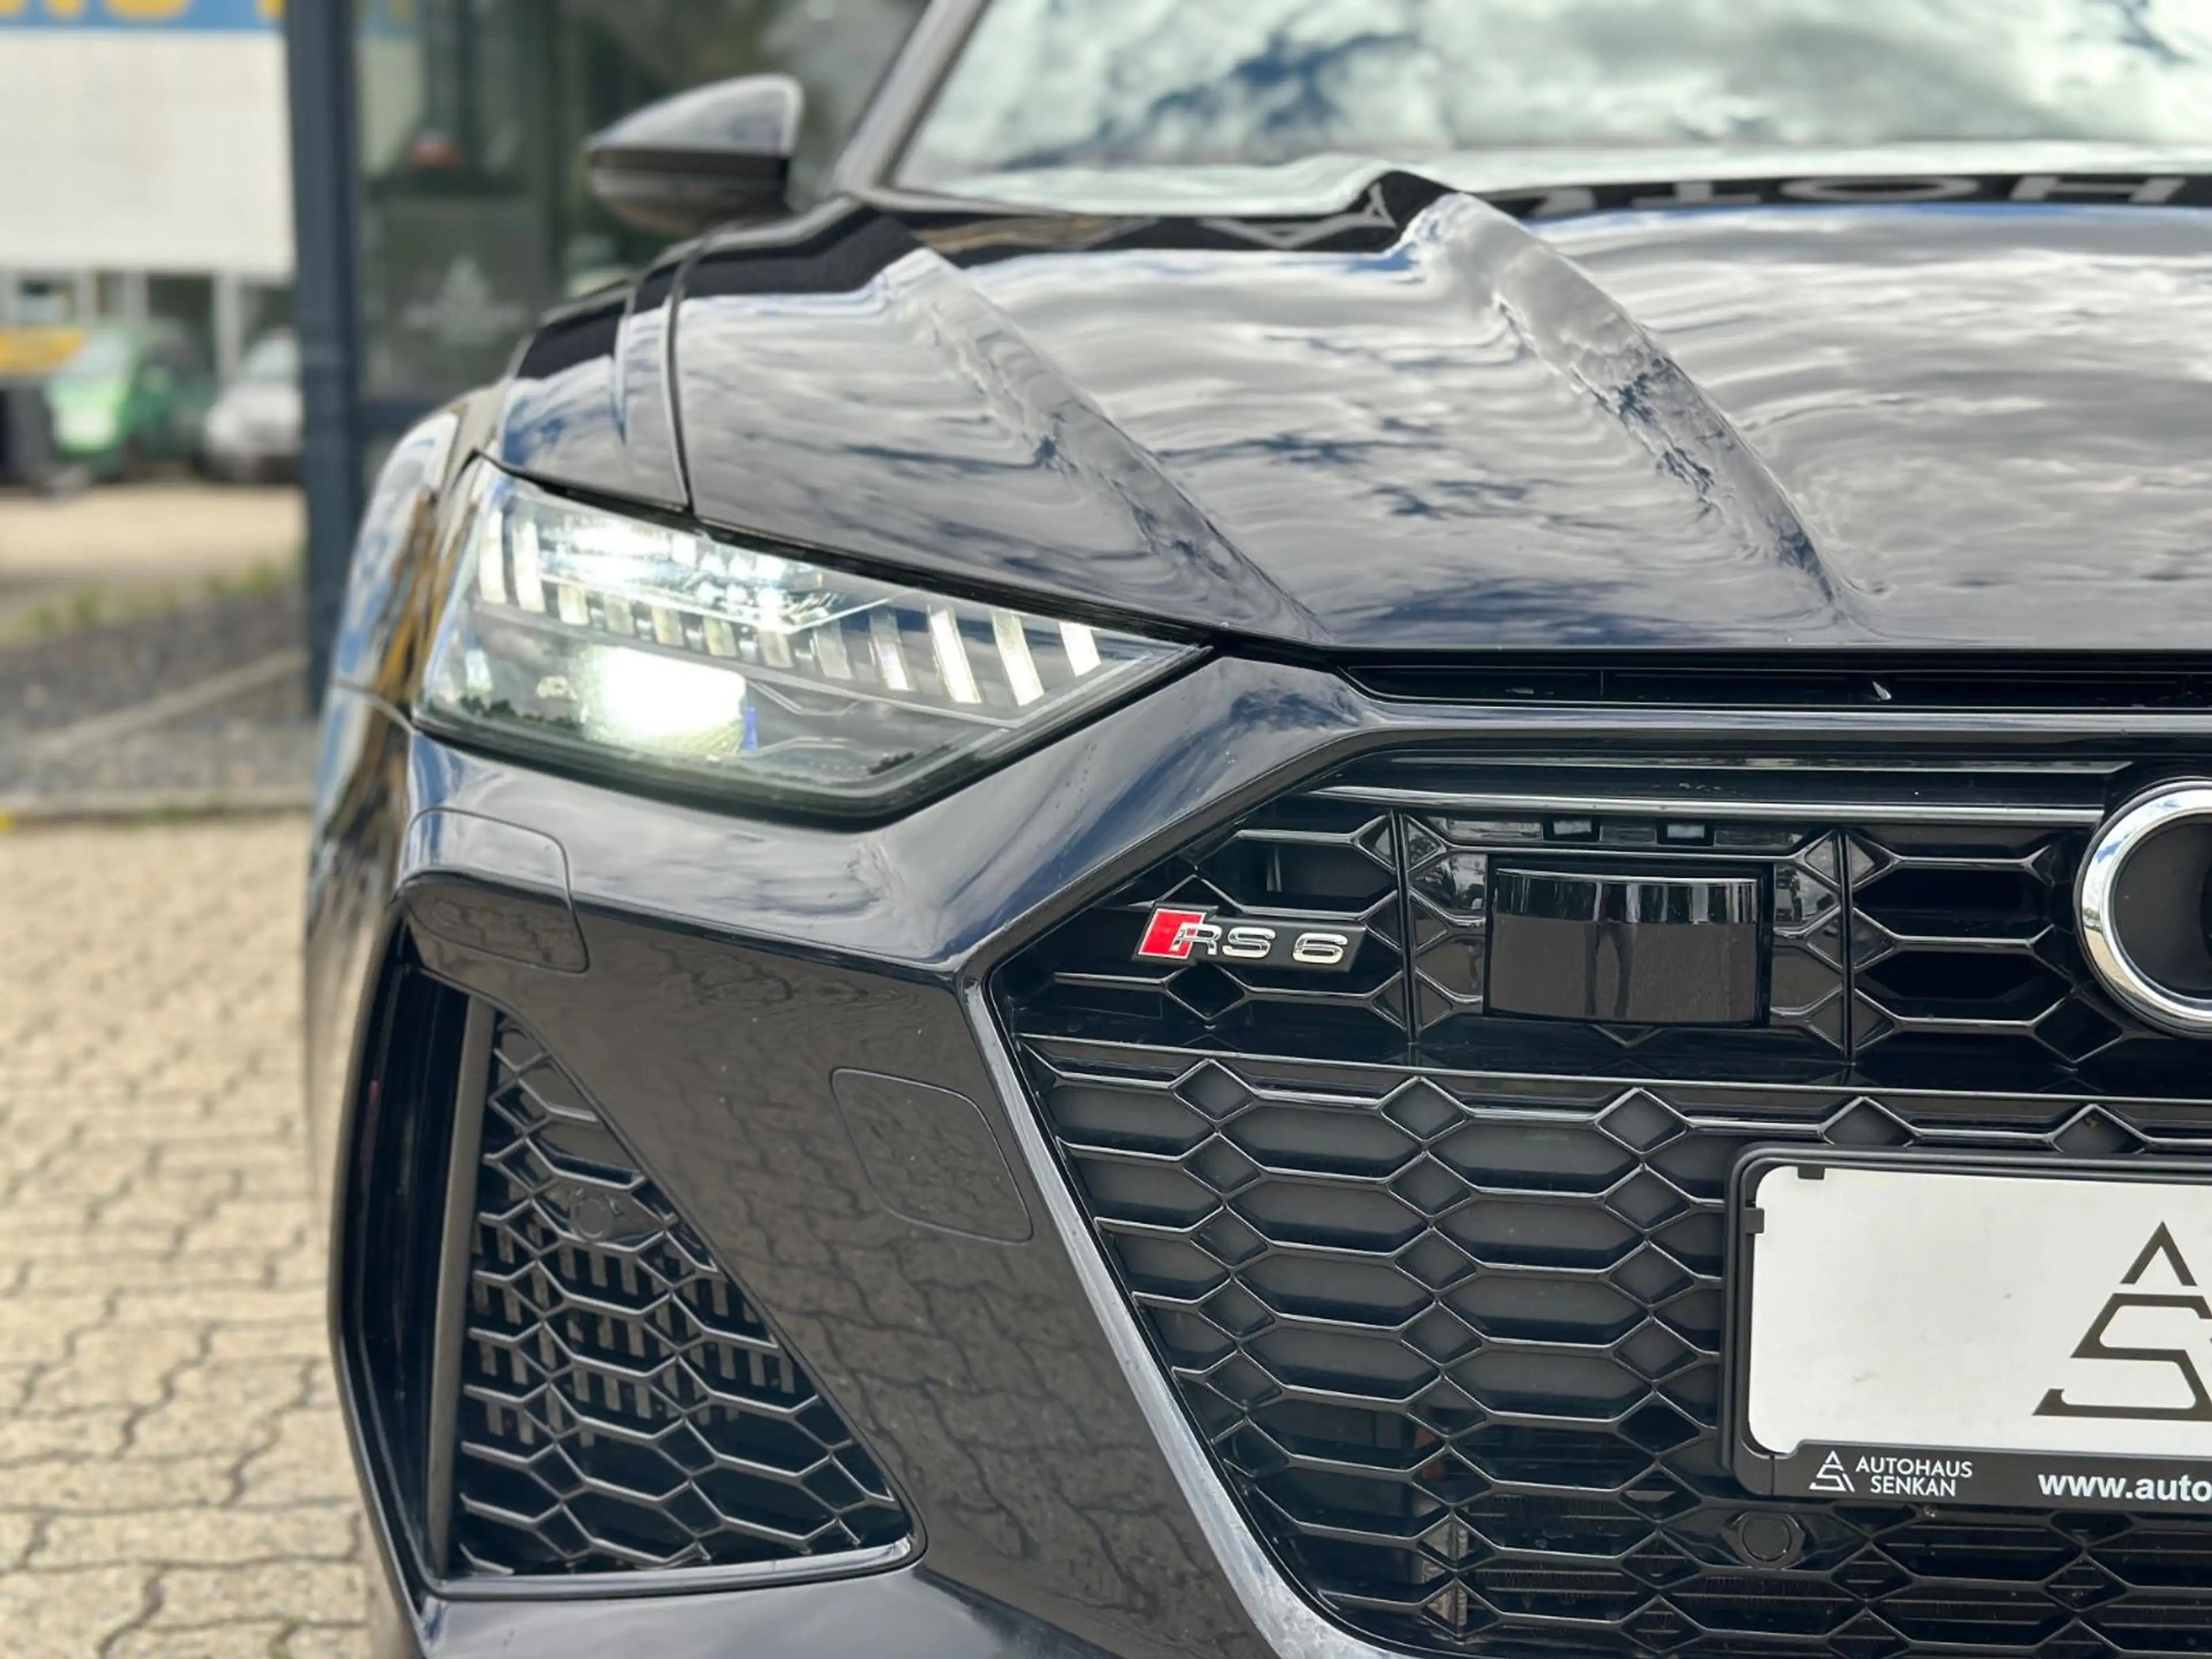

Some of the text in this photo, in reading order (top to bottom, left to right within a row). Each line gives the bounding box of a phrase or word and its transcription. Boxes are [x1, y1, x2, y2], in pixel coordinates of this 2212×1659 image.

[1167, 923, 1349, 964] RS 6
[1854, 1455, 1974, 1478] AUTOHAUS
[1870, 1475, 1956, 1497] SENKAN
